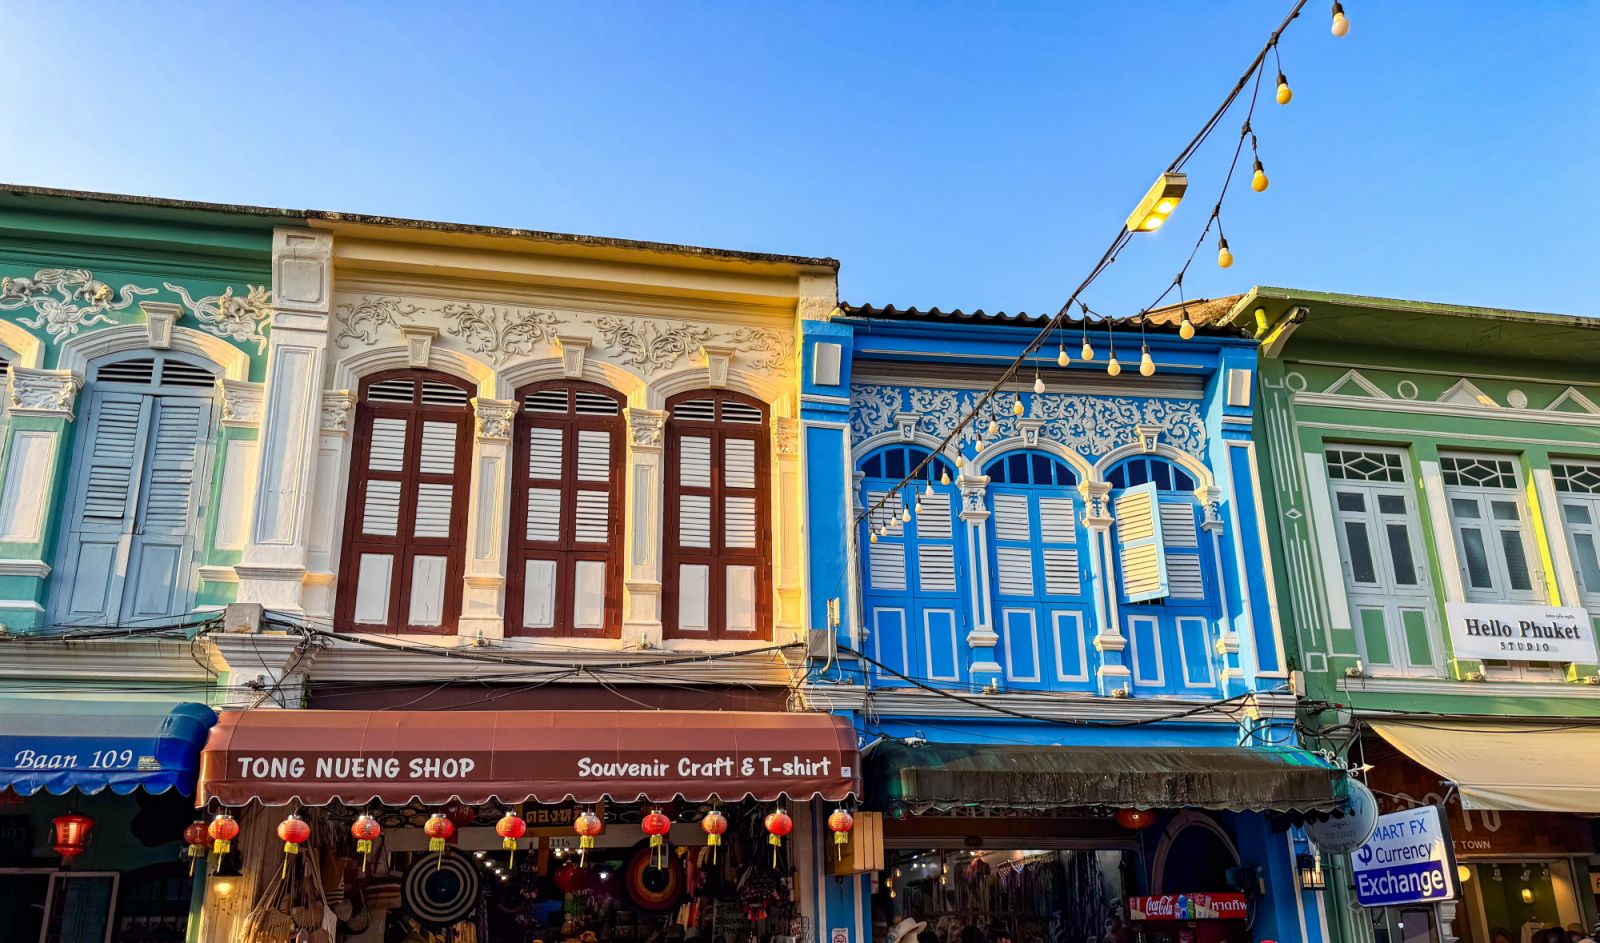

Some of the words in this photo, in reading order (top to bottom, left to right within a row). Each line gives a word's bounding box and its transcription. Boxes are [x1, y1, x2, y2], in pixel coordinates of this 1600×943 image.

[1465, 618, 1512, 637] Hello
[1518, 620, 1580, 639] Phuket
[1500, 641, 1550, 651] STUDIO
[14, 749, 78, 768] Baan
[88, 749, 133, 768] 109
[237, 757, 305, 778] TONG
[315, 757, 400, 778] NUENG
[408, 757, 475, 778] SHOP
[577, 757, 669, 777] Souvenir
[677, 756, 734, 777] Craft
[741, 757, 754, 776] &
[759, 756, 831, 777] T-shirt
[1373, 822, 1404, 842] MART
[1409, 818, 1427, 835] FX
[1376, 842, 1432, 863] Currency
[1460, 840, 1491, 849] TOWN
[1358, 869, 1444, 897] Exchange
